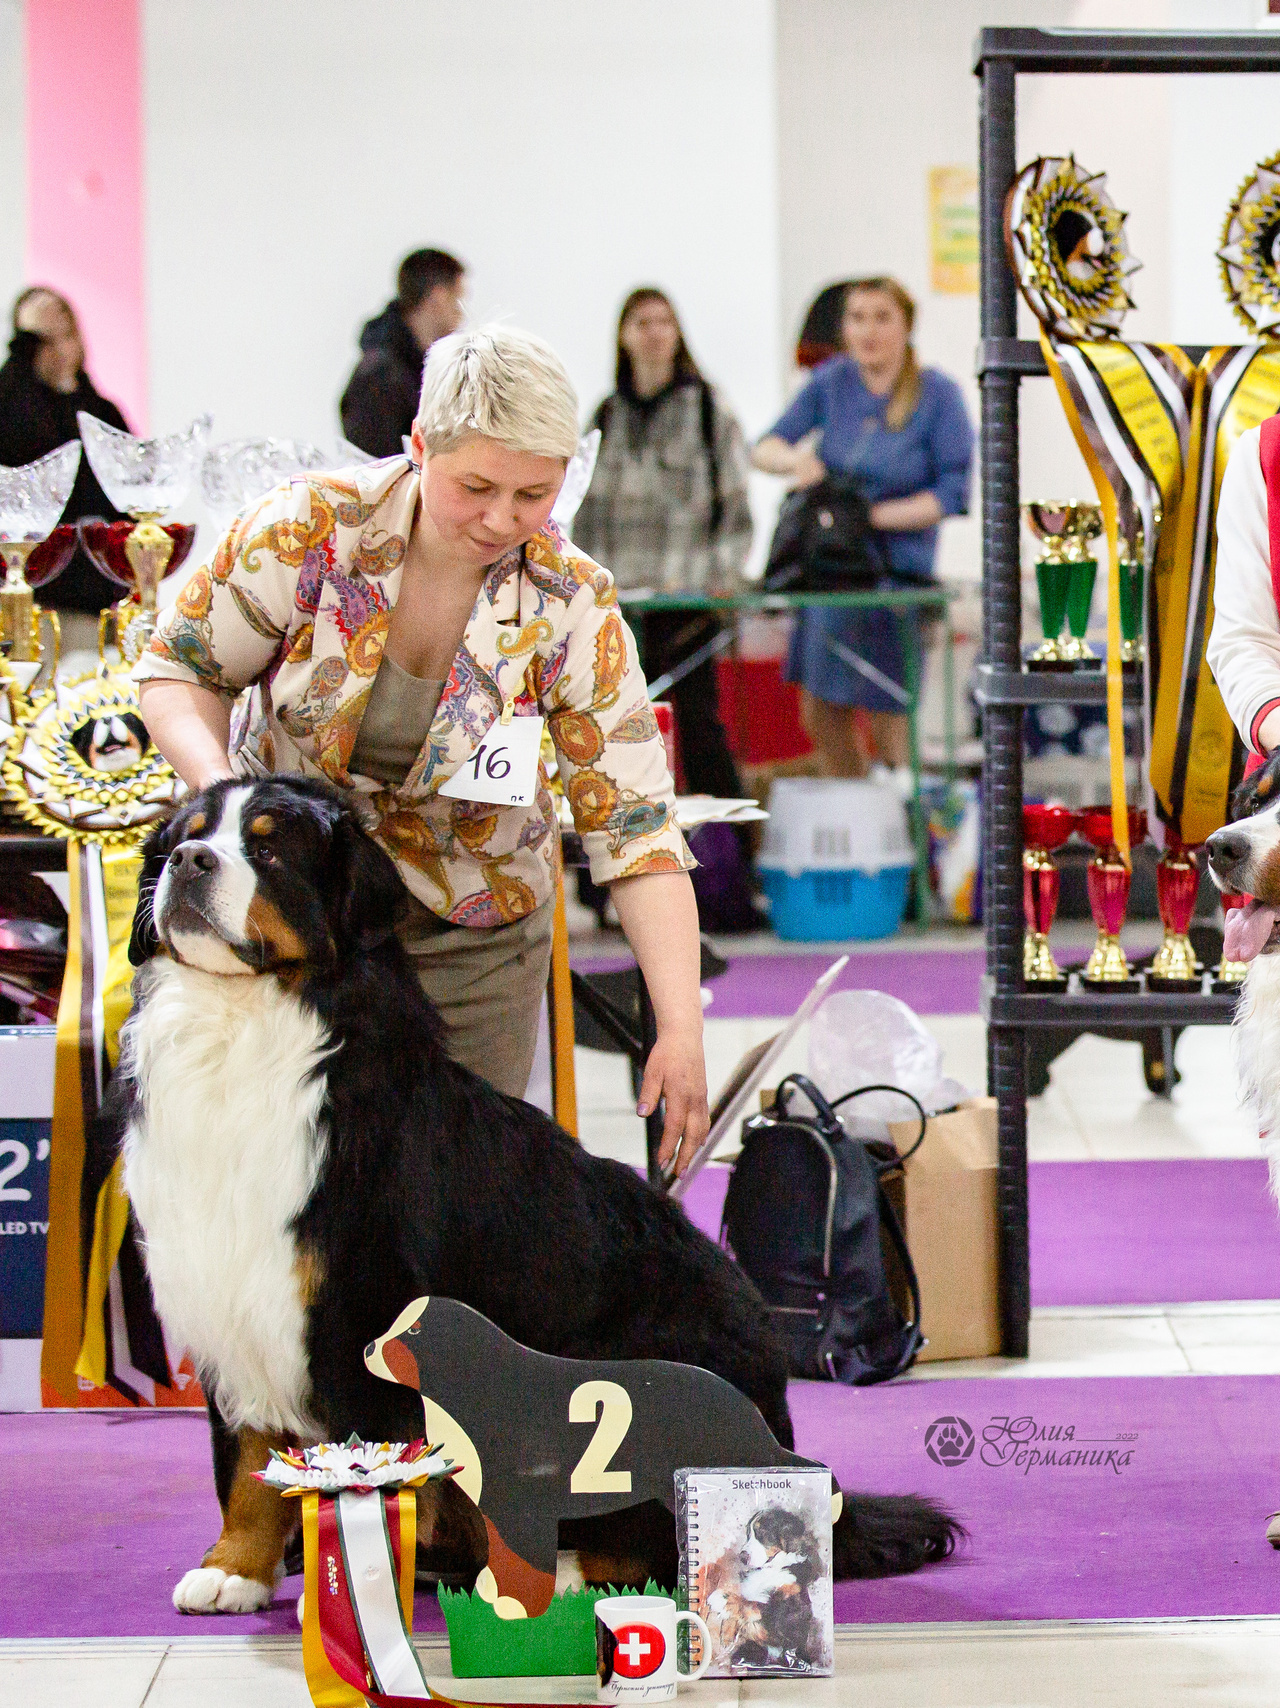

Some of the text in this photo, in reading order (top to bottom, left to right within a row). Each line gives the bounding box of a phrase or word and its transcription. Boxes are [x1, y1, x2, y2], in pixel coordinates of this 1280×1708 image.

[467, 745, 511, 780] 16
[0, 1222, 50, 1235] LED TV
[569, 1381, 632, 1493] 2
[732, 1479, 791, 1489] Sketchbook
